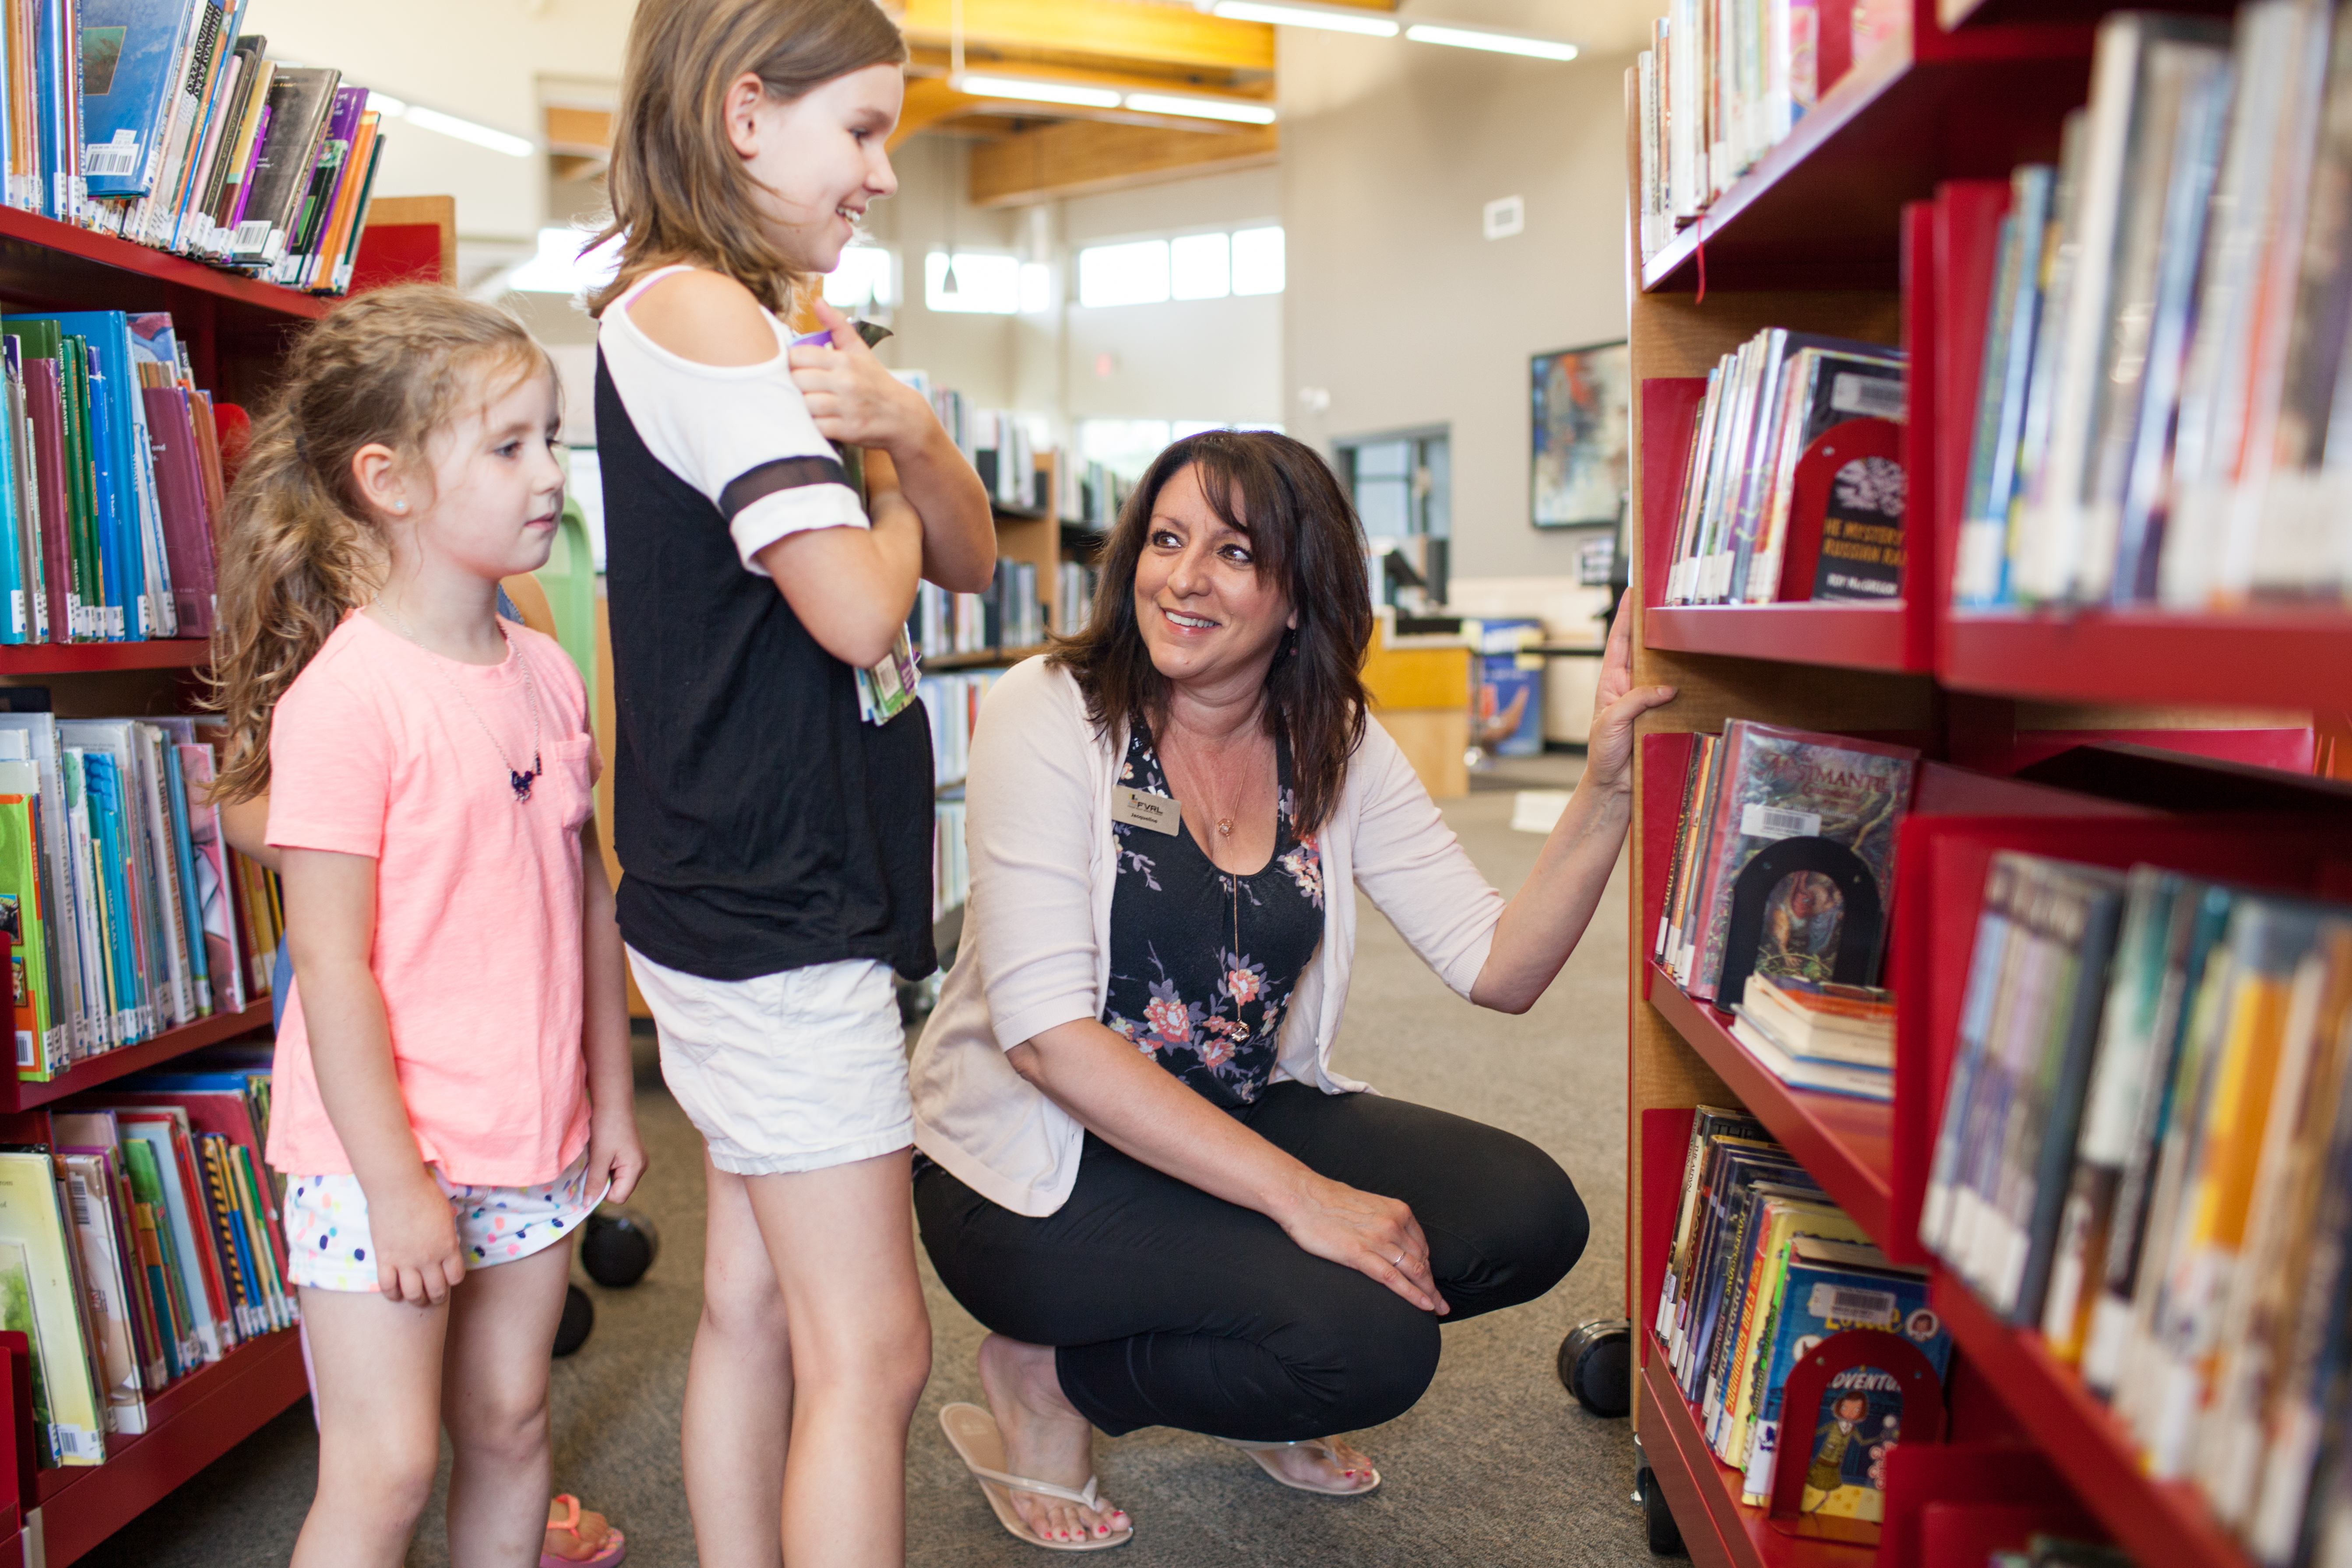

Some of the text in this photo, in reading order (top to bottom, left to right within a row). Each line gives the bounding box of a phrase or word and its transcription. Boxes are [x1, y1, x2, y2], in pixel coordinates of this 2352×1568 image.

[186, 1, 214, 93] EYEWITNESS BOOKS
[201, 8, 222, 64] EYEWITNESS
[77, 62, 83, 74] TO
[192, 63, 207, 97] BOOKS
[1823, 518, 1842, 538] HE
[1822, 538, 1881, 563] RUSSIAN
[72, 558, 81, 592] MELISSA
[1826, 572, 1846, 588] ROY
[1131, 813, 1158, 824] Jacqueline
[1137, 802, 1163, 814] FVRL
[31, 841, 39, 881] RACCOONS
[1686, 1162, 1696, 1192] AEDYN
[1740, 1290, 1757, 1329] STAR
[1826, 1372, 1902, 1392] DVENTU
